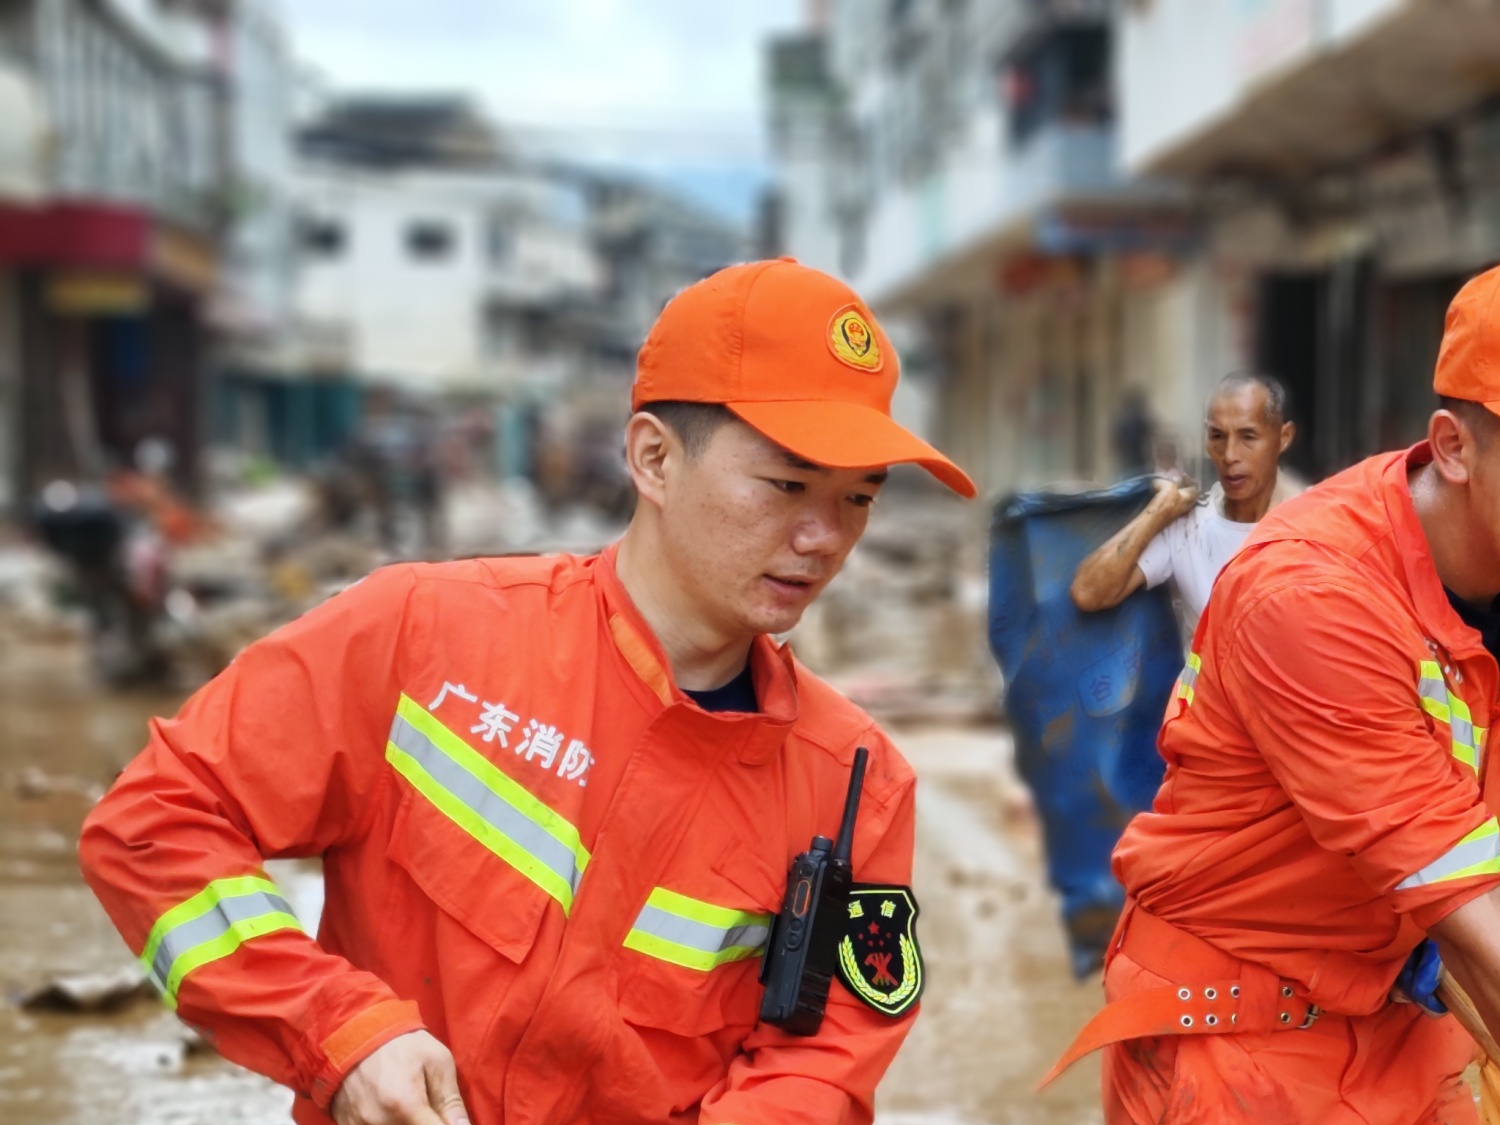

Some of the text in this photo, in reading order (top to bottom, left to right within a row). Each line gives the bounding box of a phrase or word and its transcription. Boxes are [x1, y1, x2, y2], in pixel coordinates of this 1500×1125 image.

[428, 680, 595, 788] 广东消防
[847, 899, 897, 919] 通信
